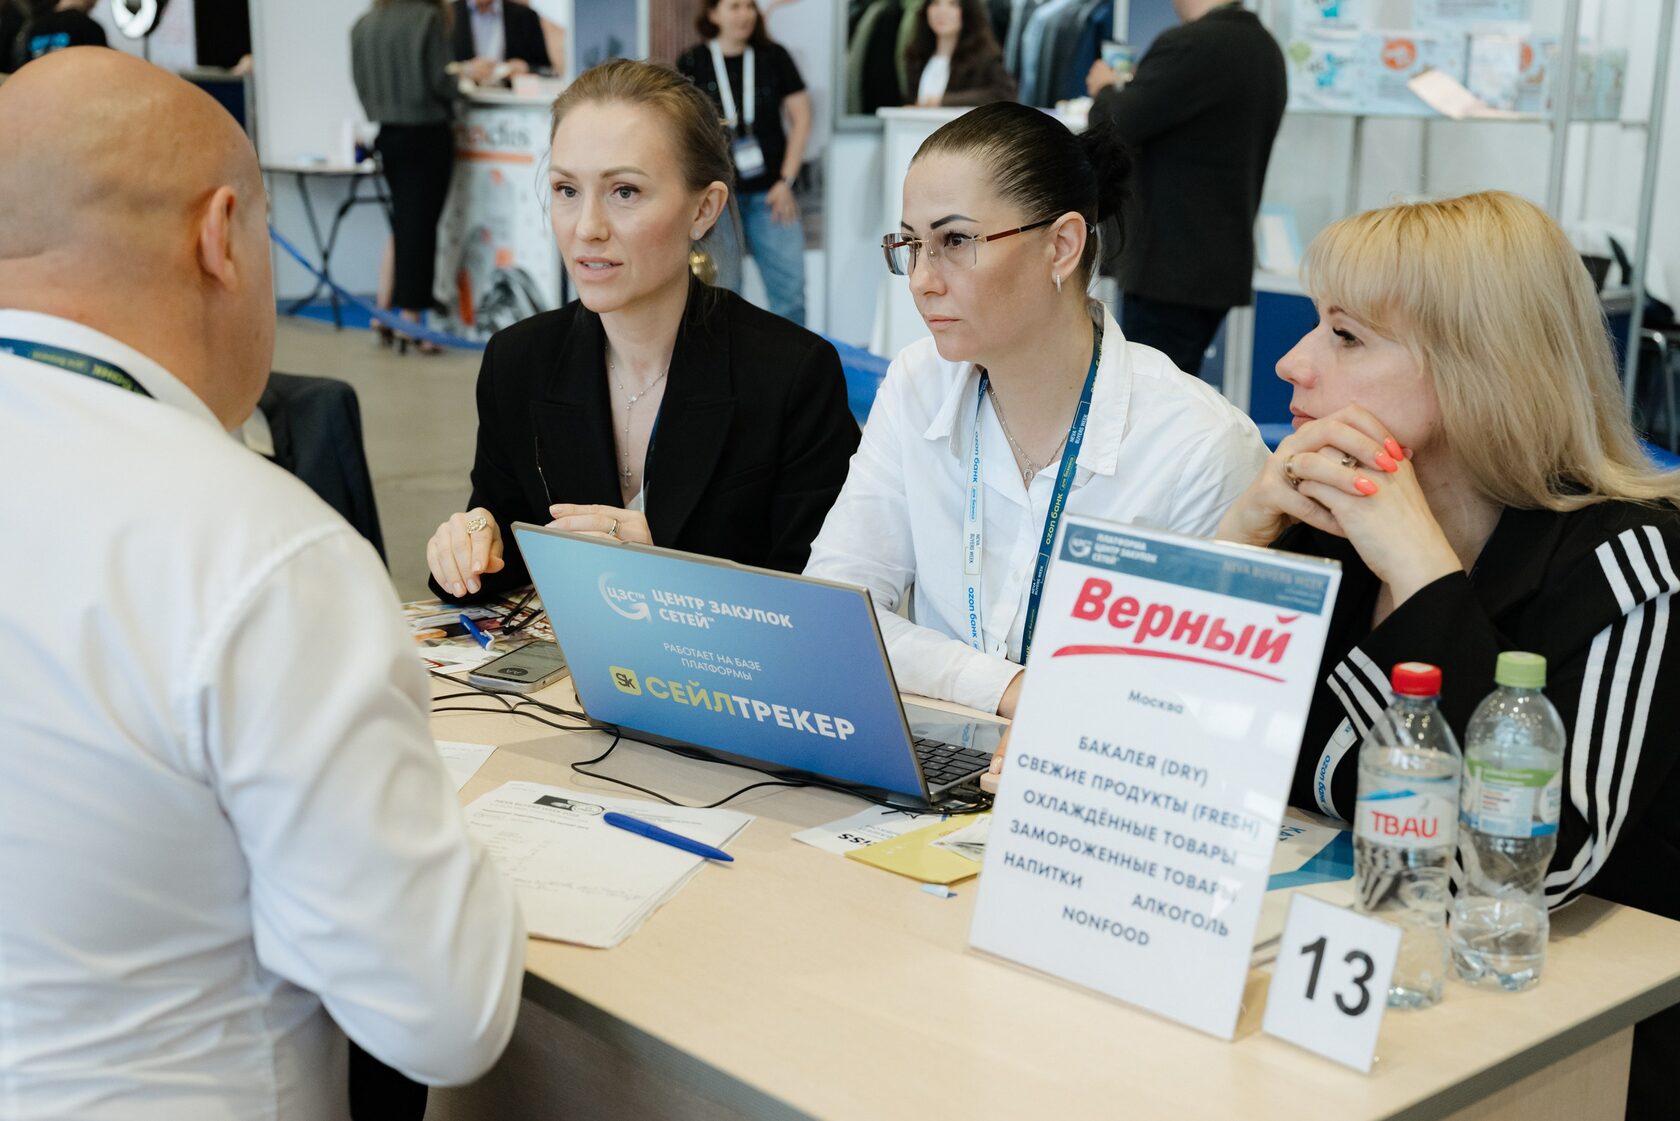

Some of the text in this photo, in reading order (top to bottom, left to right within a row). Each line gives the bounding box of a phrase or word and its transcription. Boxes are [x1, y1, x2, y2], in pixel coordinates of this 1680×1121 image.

[1046, 493, 1063, 544] ozon банк
[652, 588, 794, 629] ЦЕНТР ЗАКУПОК
[969, 613, 978, 638] банк
[1071, 577, 1302, 664] Верный
[663, 642, 762, 672] РАБОТАЕТ НА БАЗЕ
[681, 657, 753, 681] ПЛАТФОРМЫ
[645, 676, 856, 741] СЕЙЛТРЕКЕР
[1127, 690, 1185, 715] Москва
[1078, 735, 1209, 788] БАКАЛЕЯ (DRY)
[1320, 755, 1331, 781] ozon
[1017, 753, 1088, 785] СВЕЖИЕ
[1091, 774, 1188, 814] ПРОДУКТЫ
[1192, 803, 1261, 841] (FRESH)
[1009, 819, 1158, 879] ЗАМОРОЖЕННЫЕ
[1023, 789, 1237, 866] ОХЛАЖДЁННЫЕ ТОВАРЫ
[1003, 851, 1230, 937] НАПИТКИ АЛКОГОЛЬ
[1062, 905, 1150, 947] NONFOOD
[1299, 935, 1375, 1017] 13
